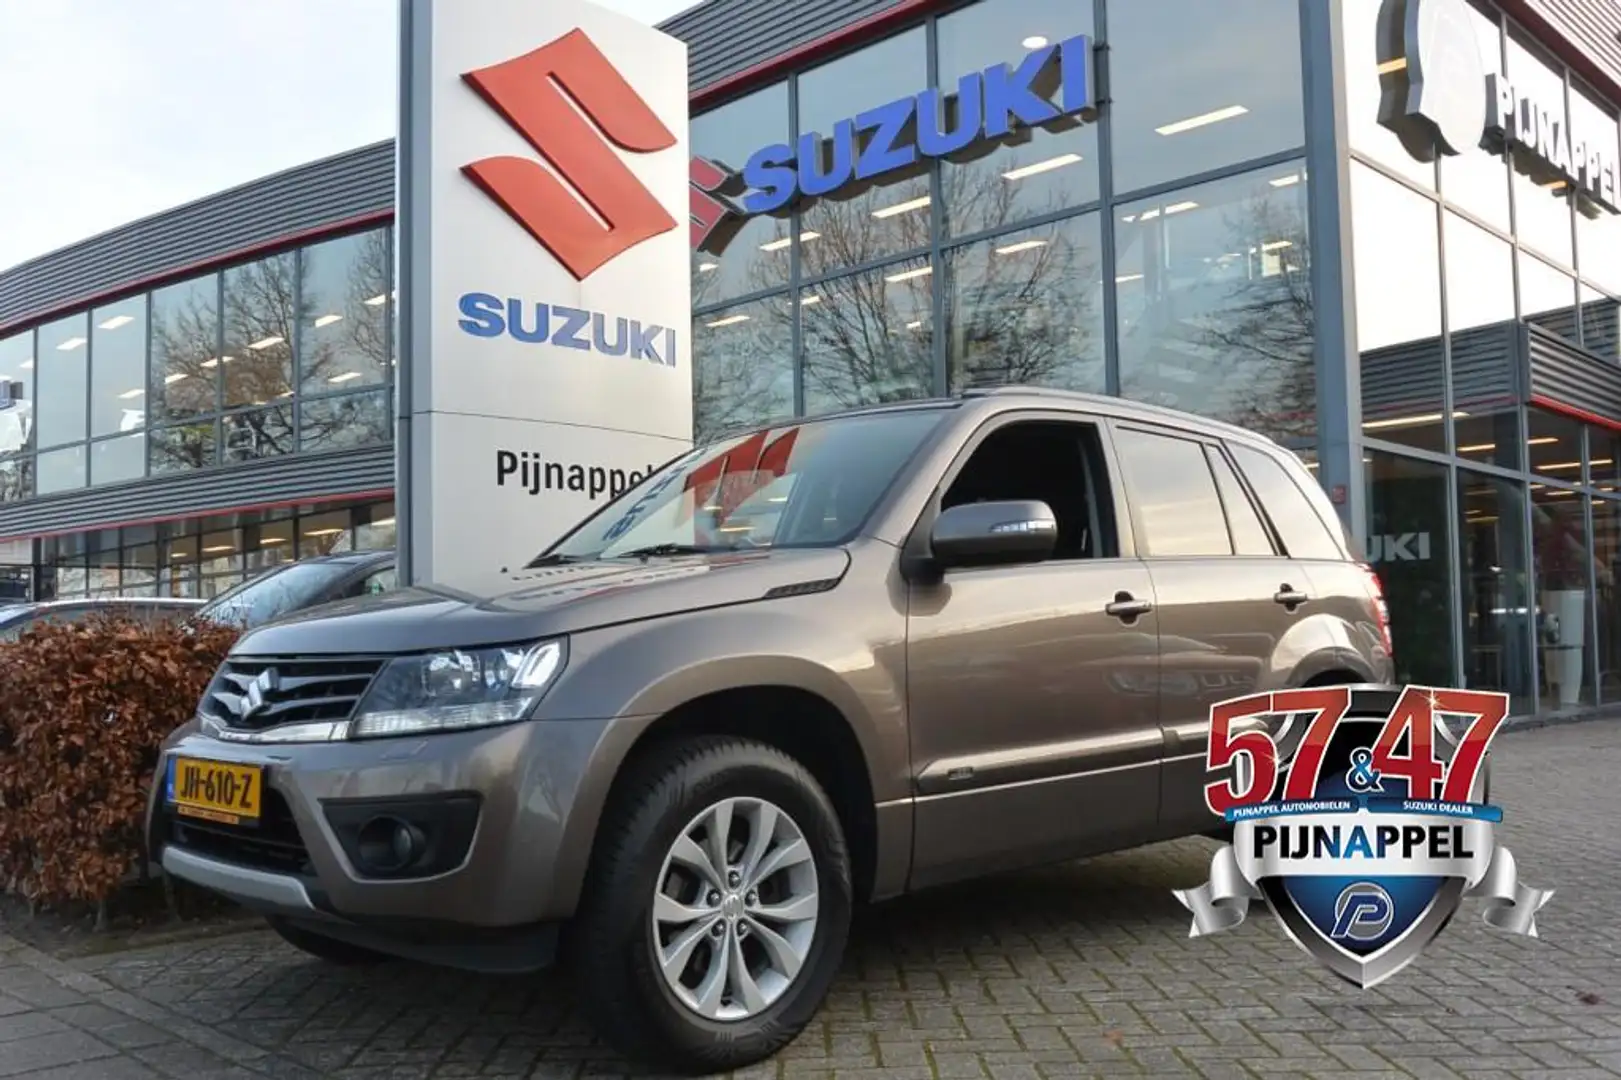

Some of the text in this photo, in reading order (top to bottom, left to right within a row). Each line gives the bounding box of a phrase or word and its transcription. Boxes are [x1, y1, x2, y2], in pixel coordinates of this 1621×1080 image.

[743, 34, 1093, 214] SUZUKI
[458, 292, 676, 368] SUZUKI
[181, 765, 252, 809] JH-610-Z
